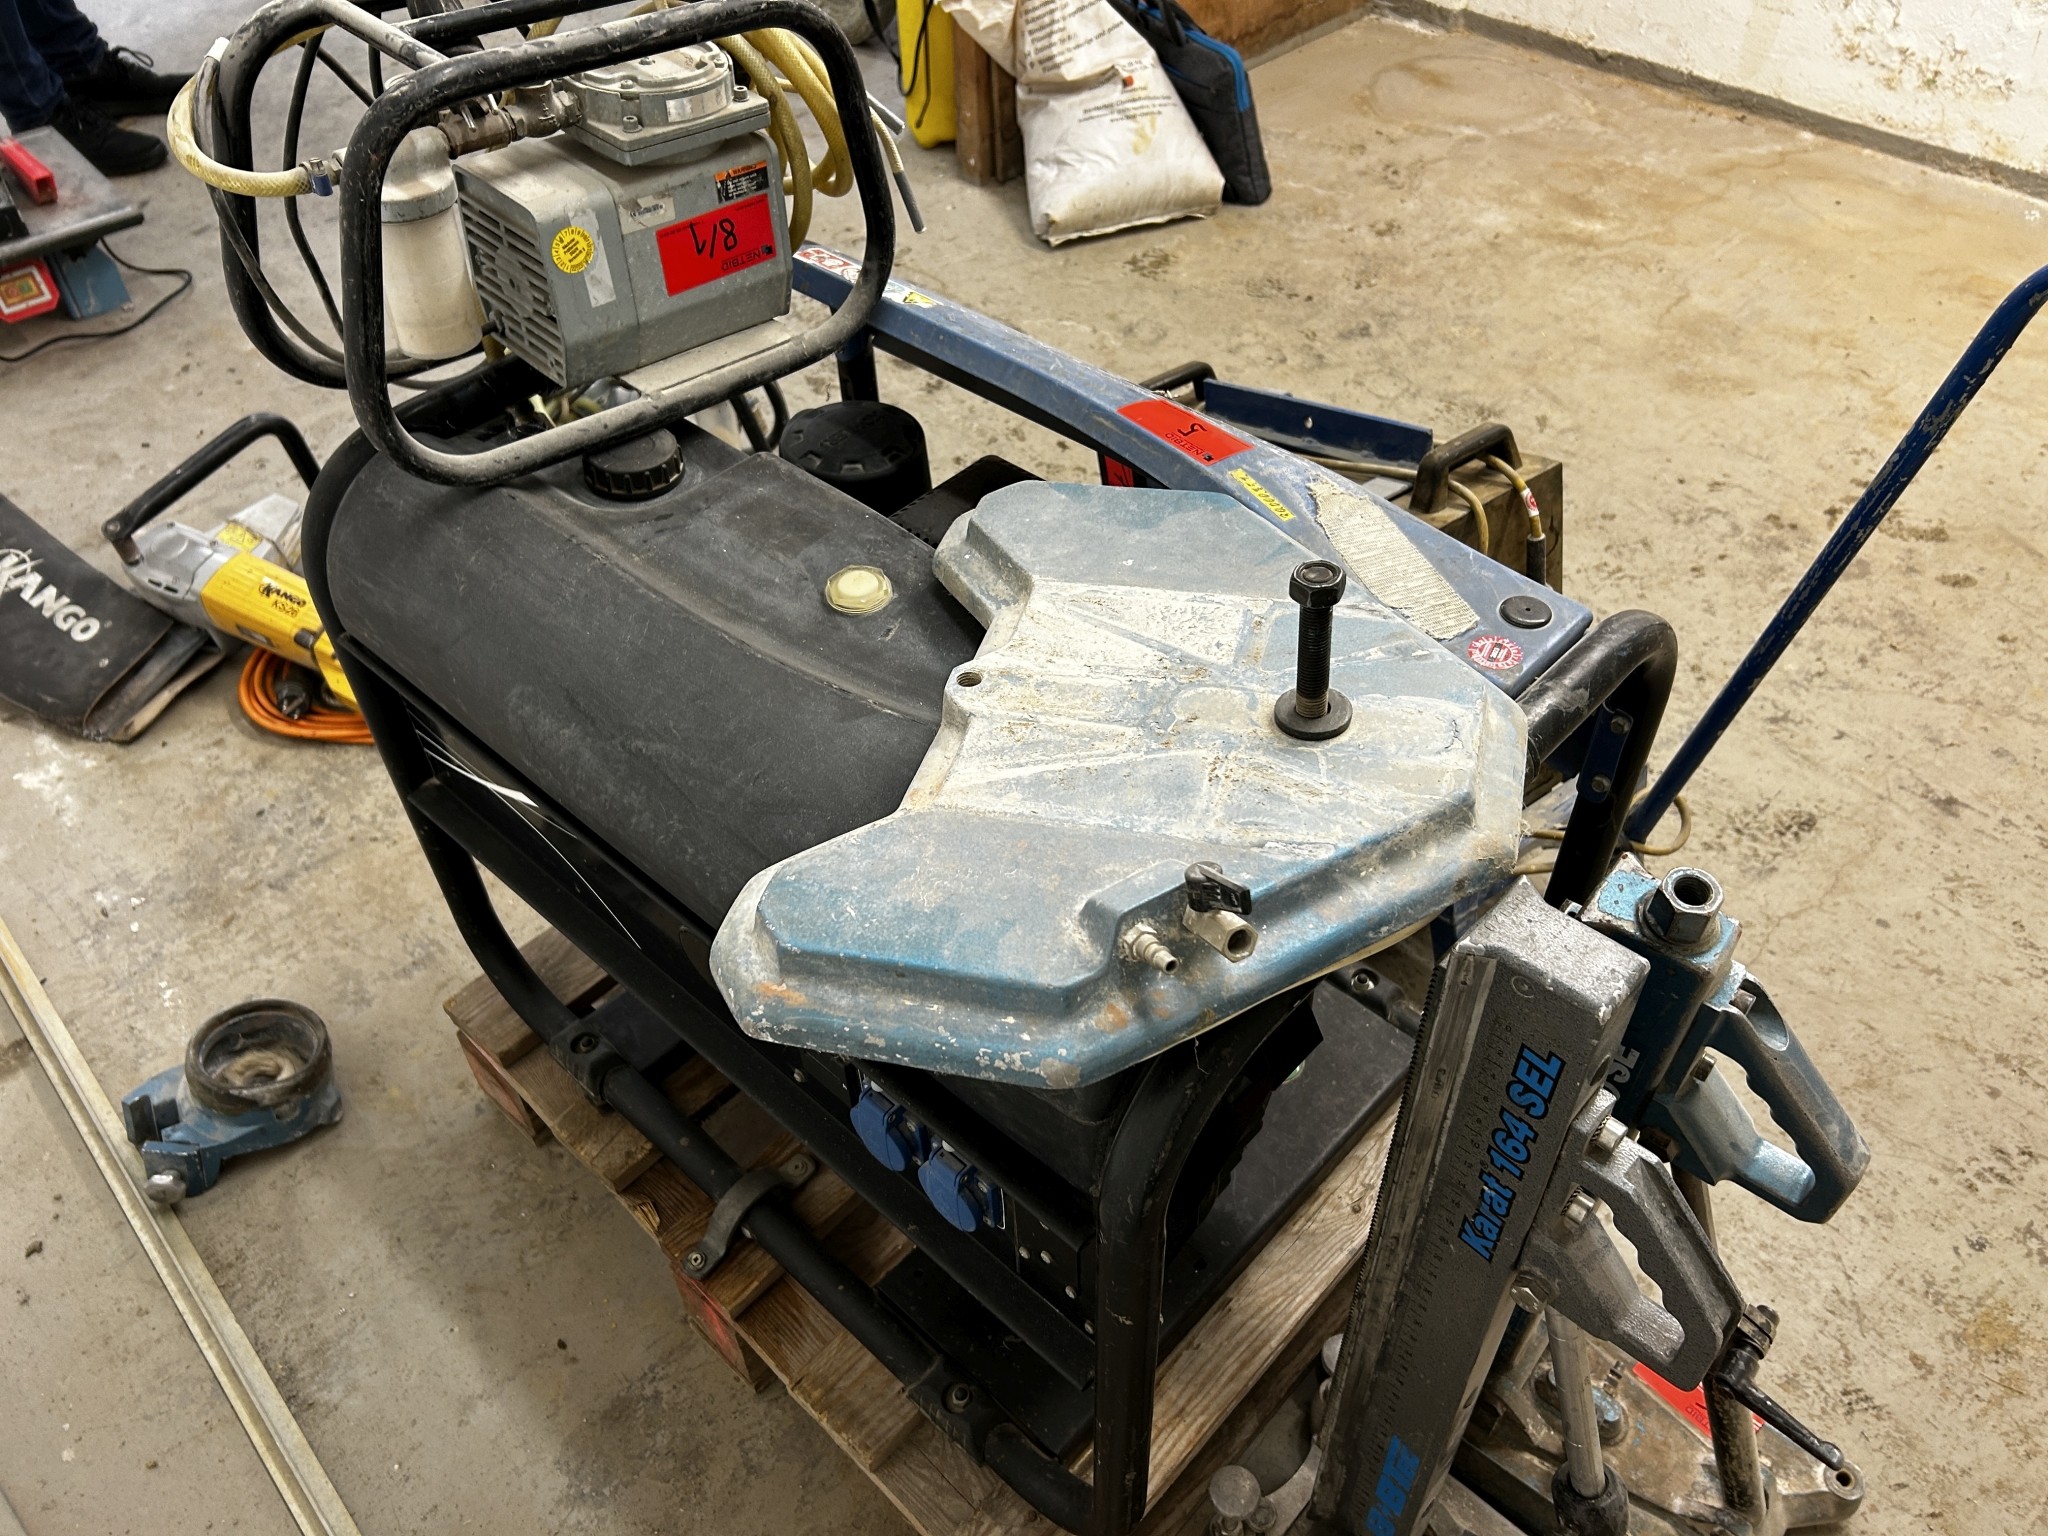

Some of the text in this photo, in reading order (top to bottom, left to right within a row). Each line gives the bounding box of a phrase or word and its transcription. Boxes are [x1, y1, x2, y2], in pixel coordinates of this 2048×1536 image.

[690, 218, 737, 259] 8/1
[721, 250, 760, 272] NETBID
[1177, 422, 1207, 437] 5
[1165, 432, 1204, 456] NETBID
[260, 583, 307, 608] KANGO
[1457, 1042, 1567, 1263] Karat 164 SEL
[1685, 1403, 1709, 1429] TBID
